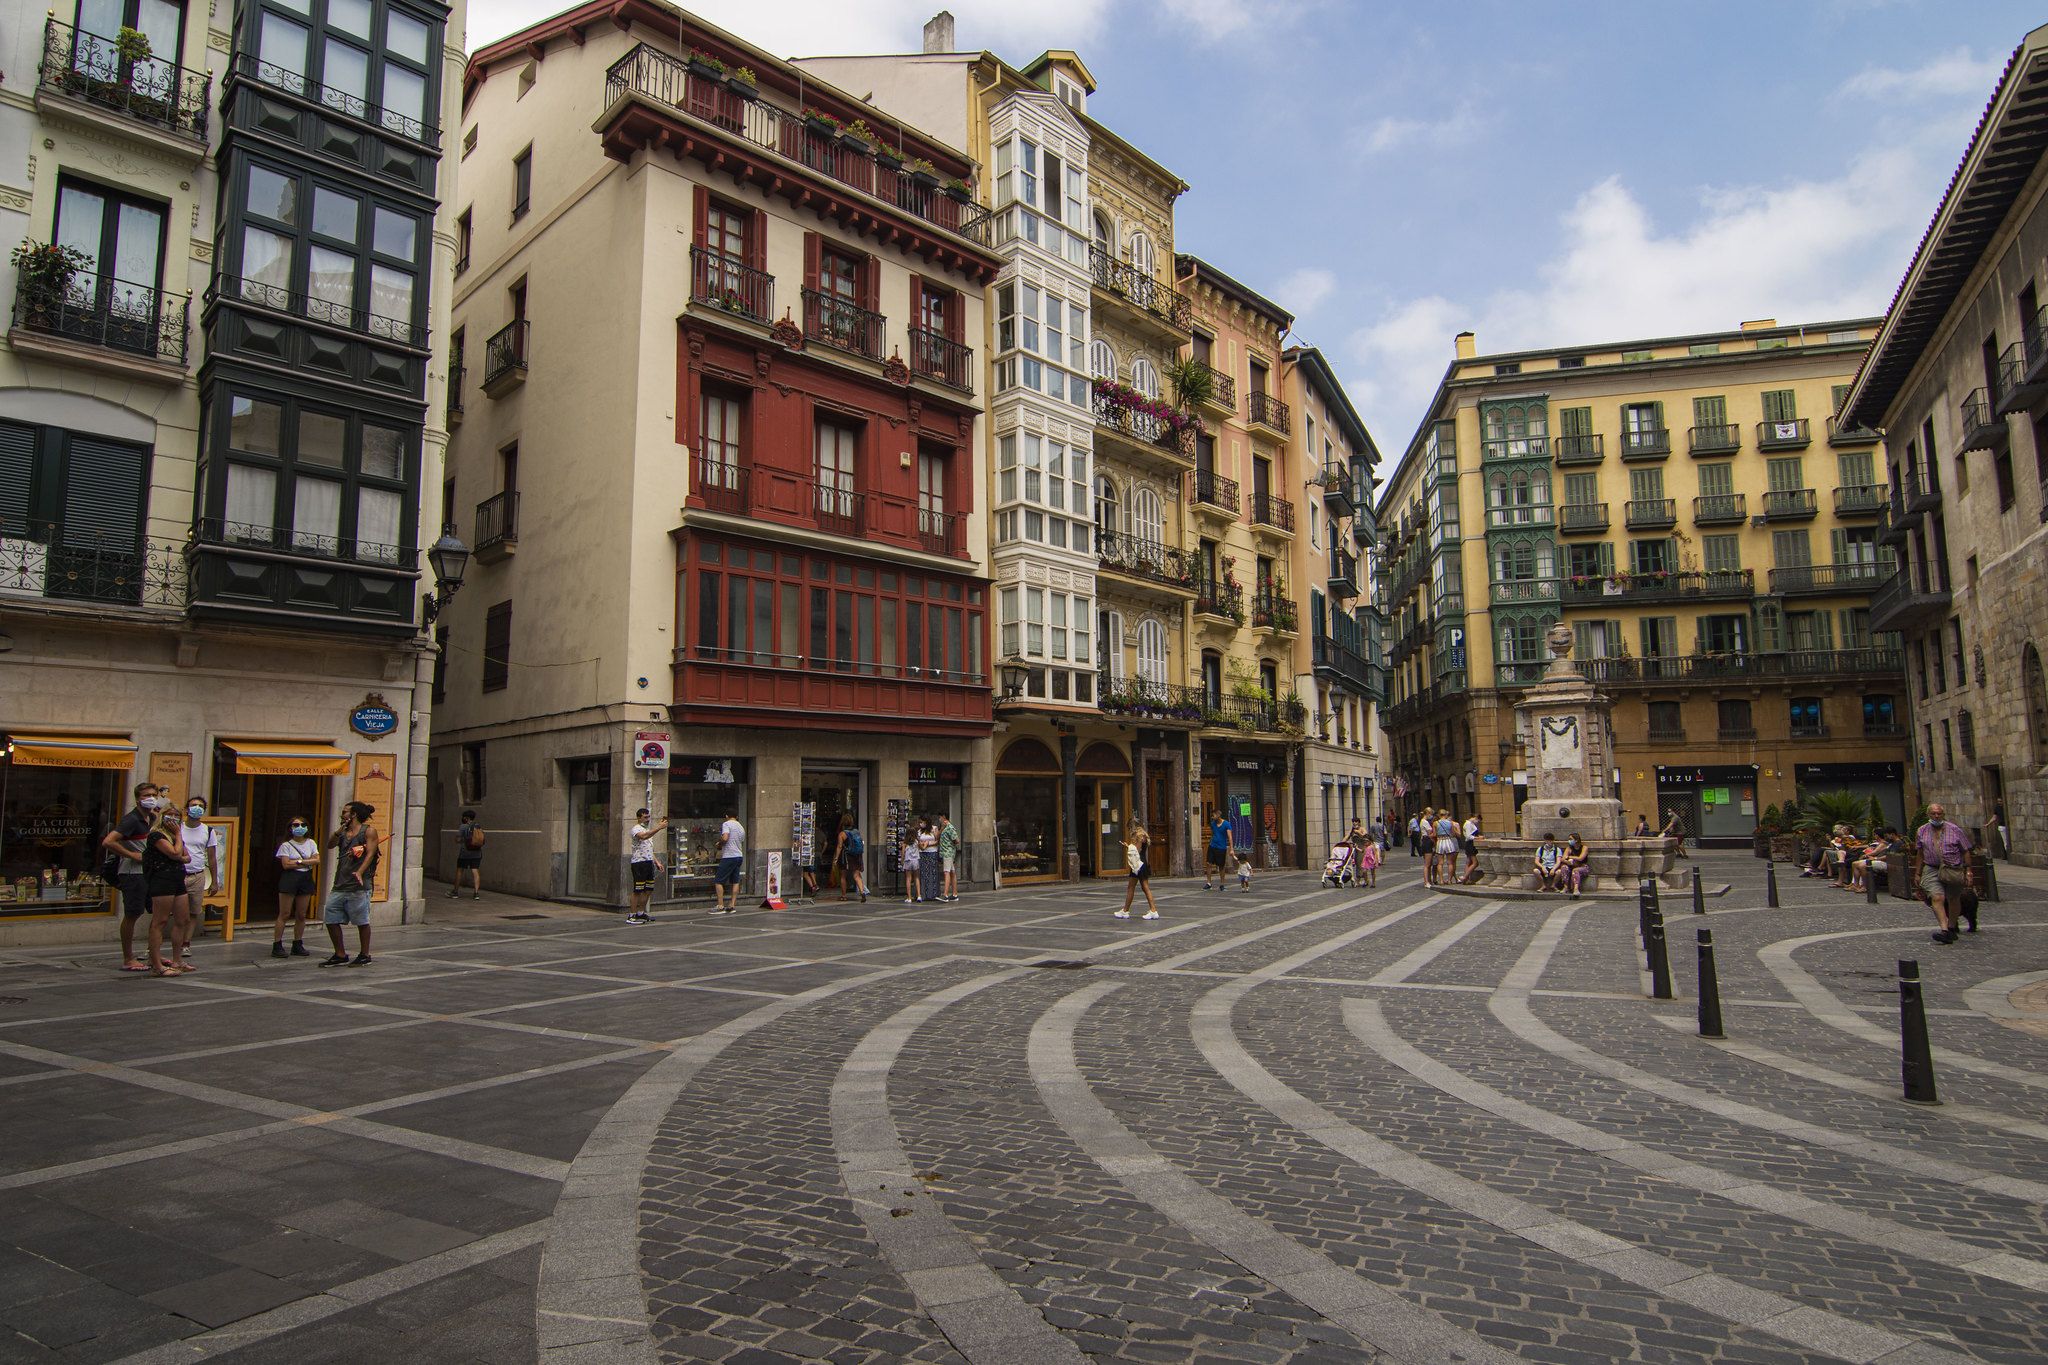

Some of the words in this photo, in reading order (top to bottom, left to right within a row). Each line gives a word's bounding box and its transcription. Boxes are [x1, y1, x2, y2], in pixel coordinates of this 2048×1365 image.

[1450, 628, 1463, 647] P
[14, 756, 28, 764] LA
[31, 757, 62, 766] CURE
[64, 759, 135, 769] GOURMANDE
[245, 766, 258, 774] LA
[260, 767, 286, 775] CURE
[287, 767, 343, 775] GOURMANDE
[33, 819, 47, 827] LA
[50, 819, 80, 827] CURE
[19, 827, 92, 835] GOURMANDE
